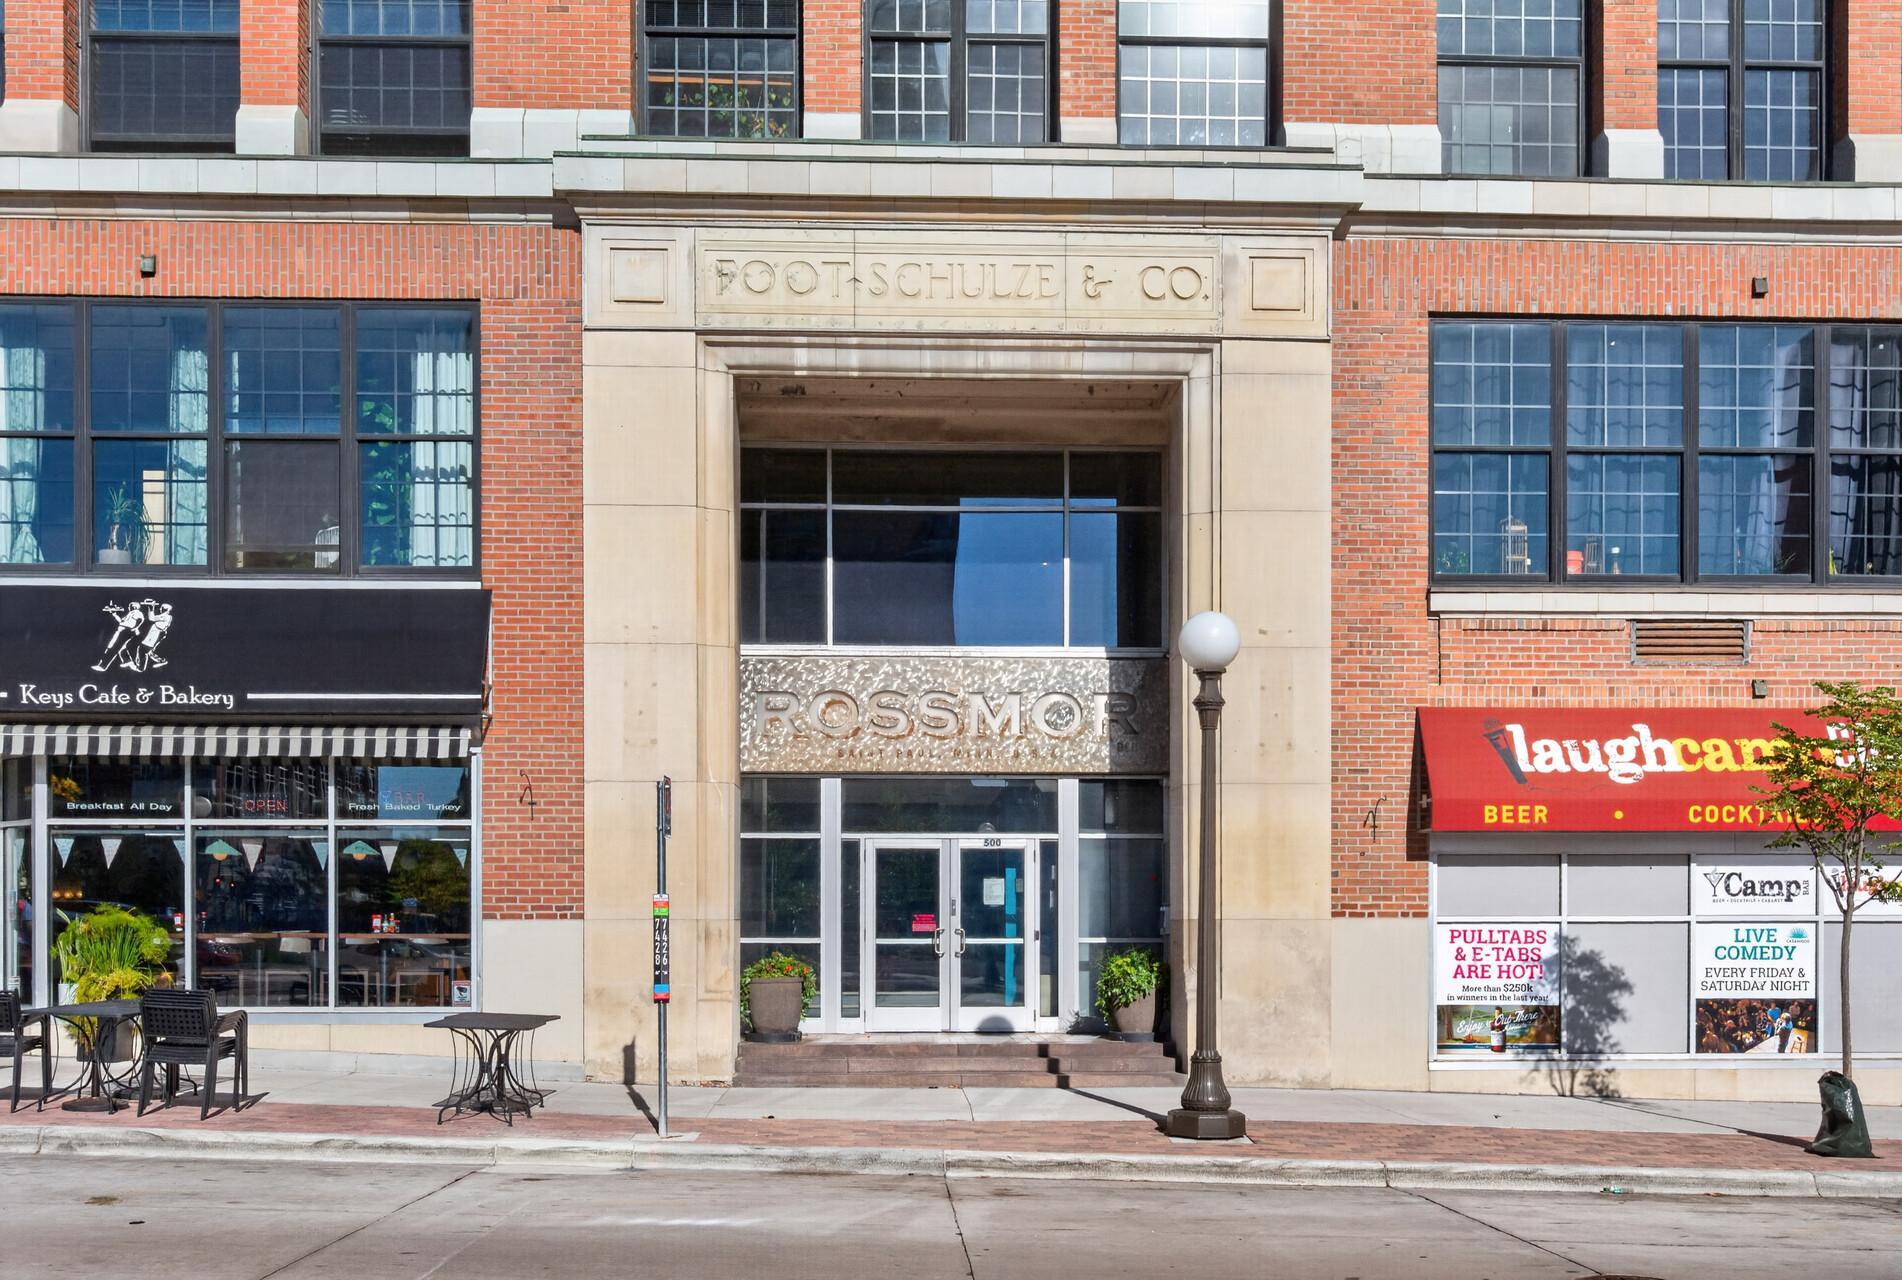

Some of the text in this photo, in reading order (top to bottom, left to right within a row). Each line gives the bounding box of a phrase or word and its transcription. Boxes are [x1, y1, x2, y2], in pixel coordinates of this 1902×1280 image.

[868, 262, 1060, 300] SCHULZE
[1083, 264, 1113, 298] &
[19, 684, 234, 709] Keys Cafe & Bakery
[755, 689, 1140, 738] ROSSMOR
[66, 802, 172, 811] Breakfast All Day
[244, 800, 287, 812] OPEN
[349, 803, 461, 812] Fresh Baked Turkey
[1484, 805, 1548, 823] BEER
[984, 838, 1001, 847] 500
[1724, 872, 1801, 902] Camp
[1449, 929, 1547, 944] PULLTABS
[1734, 928, 1777, 943] LIVE
[1455, 947, 1542, 962] & E-TABS
[1714, 945, 1797, 960] COMEDY
[1453, 964, 1544, 980] ARE HOT!
[1705, 967, 1806, 978] EVERY FRIDAY &
[1484, 984, 1501, 992] than
[1503, 983, 1533, 993] $250k
[1700, 980, 1810, 991] SATURDAY NIGHT
[1499, 993, 1512, 1001] the
[1514, 993, 1527, 1001] last
